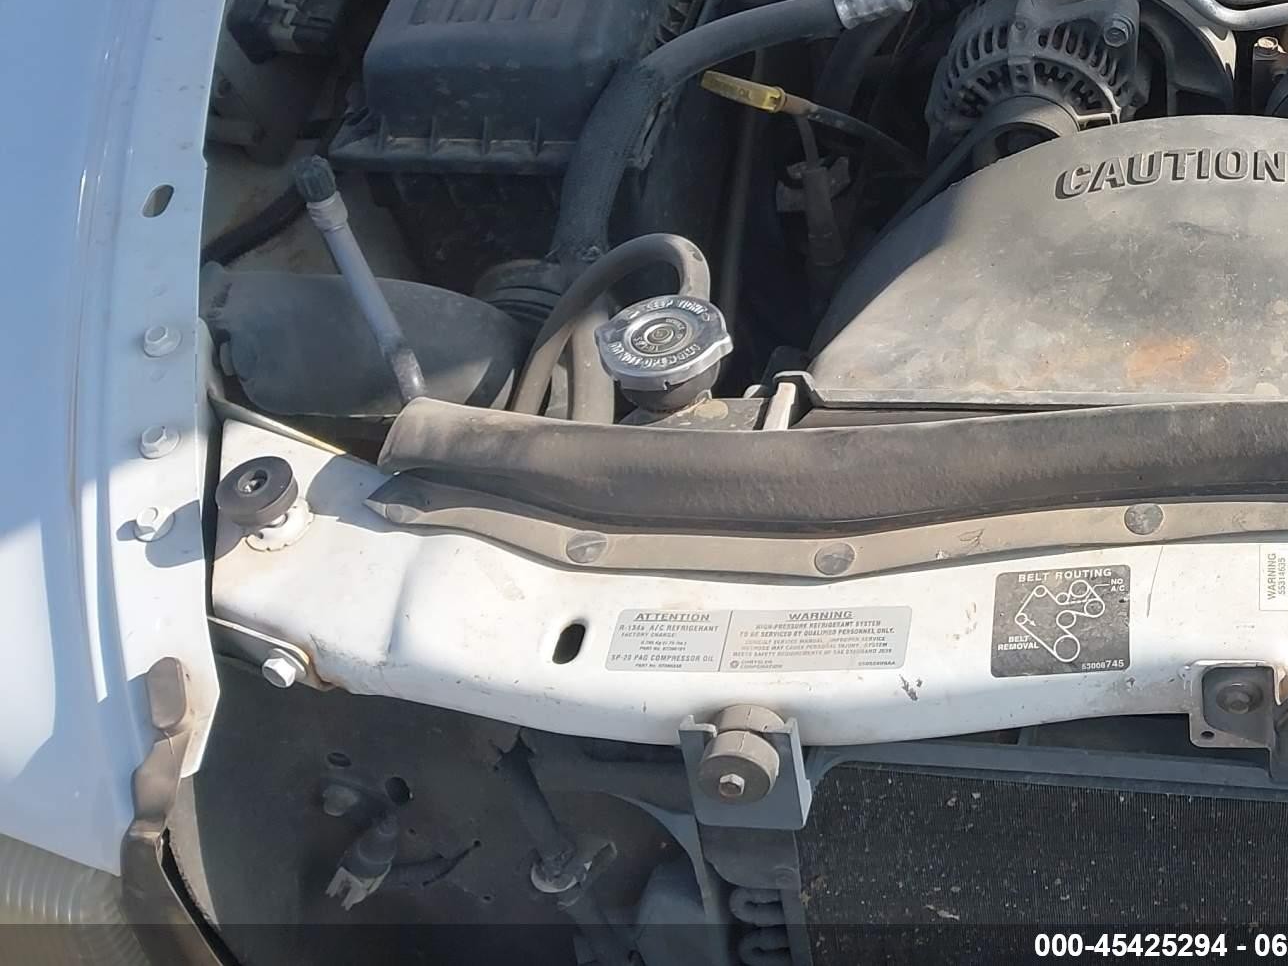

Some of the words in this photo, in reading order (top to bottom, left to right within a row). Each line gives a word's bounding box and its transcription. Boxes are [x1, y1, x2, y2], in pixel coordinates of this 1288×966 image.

[1055, 147, 1287, 200] CAUTION
[1018, 572, 1050, 582] BELT
[1055, 568, 1112, 580] ROUTING
[1267, 553, 1277, 600] WARNING
[1110, 584, 1125, 592] A/C
[635, 613, 711, 621] ATTENTION
[788, 611, 853, 620] WARNING
[649, 624, 665, 632] A/C
[809, 621, 854, 629] REFRIGERANT
[1008, 635, 1029, 643] BELT
[997, 641, 1040, 651] REMOVAL
[650, 654, 701, 662] COMPRESSOR
